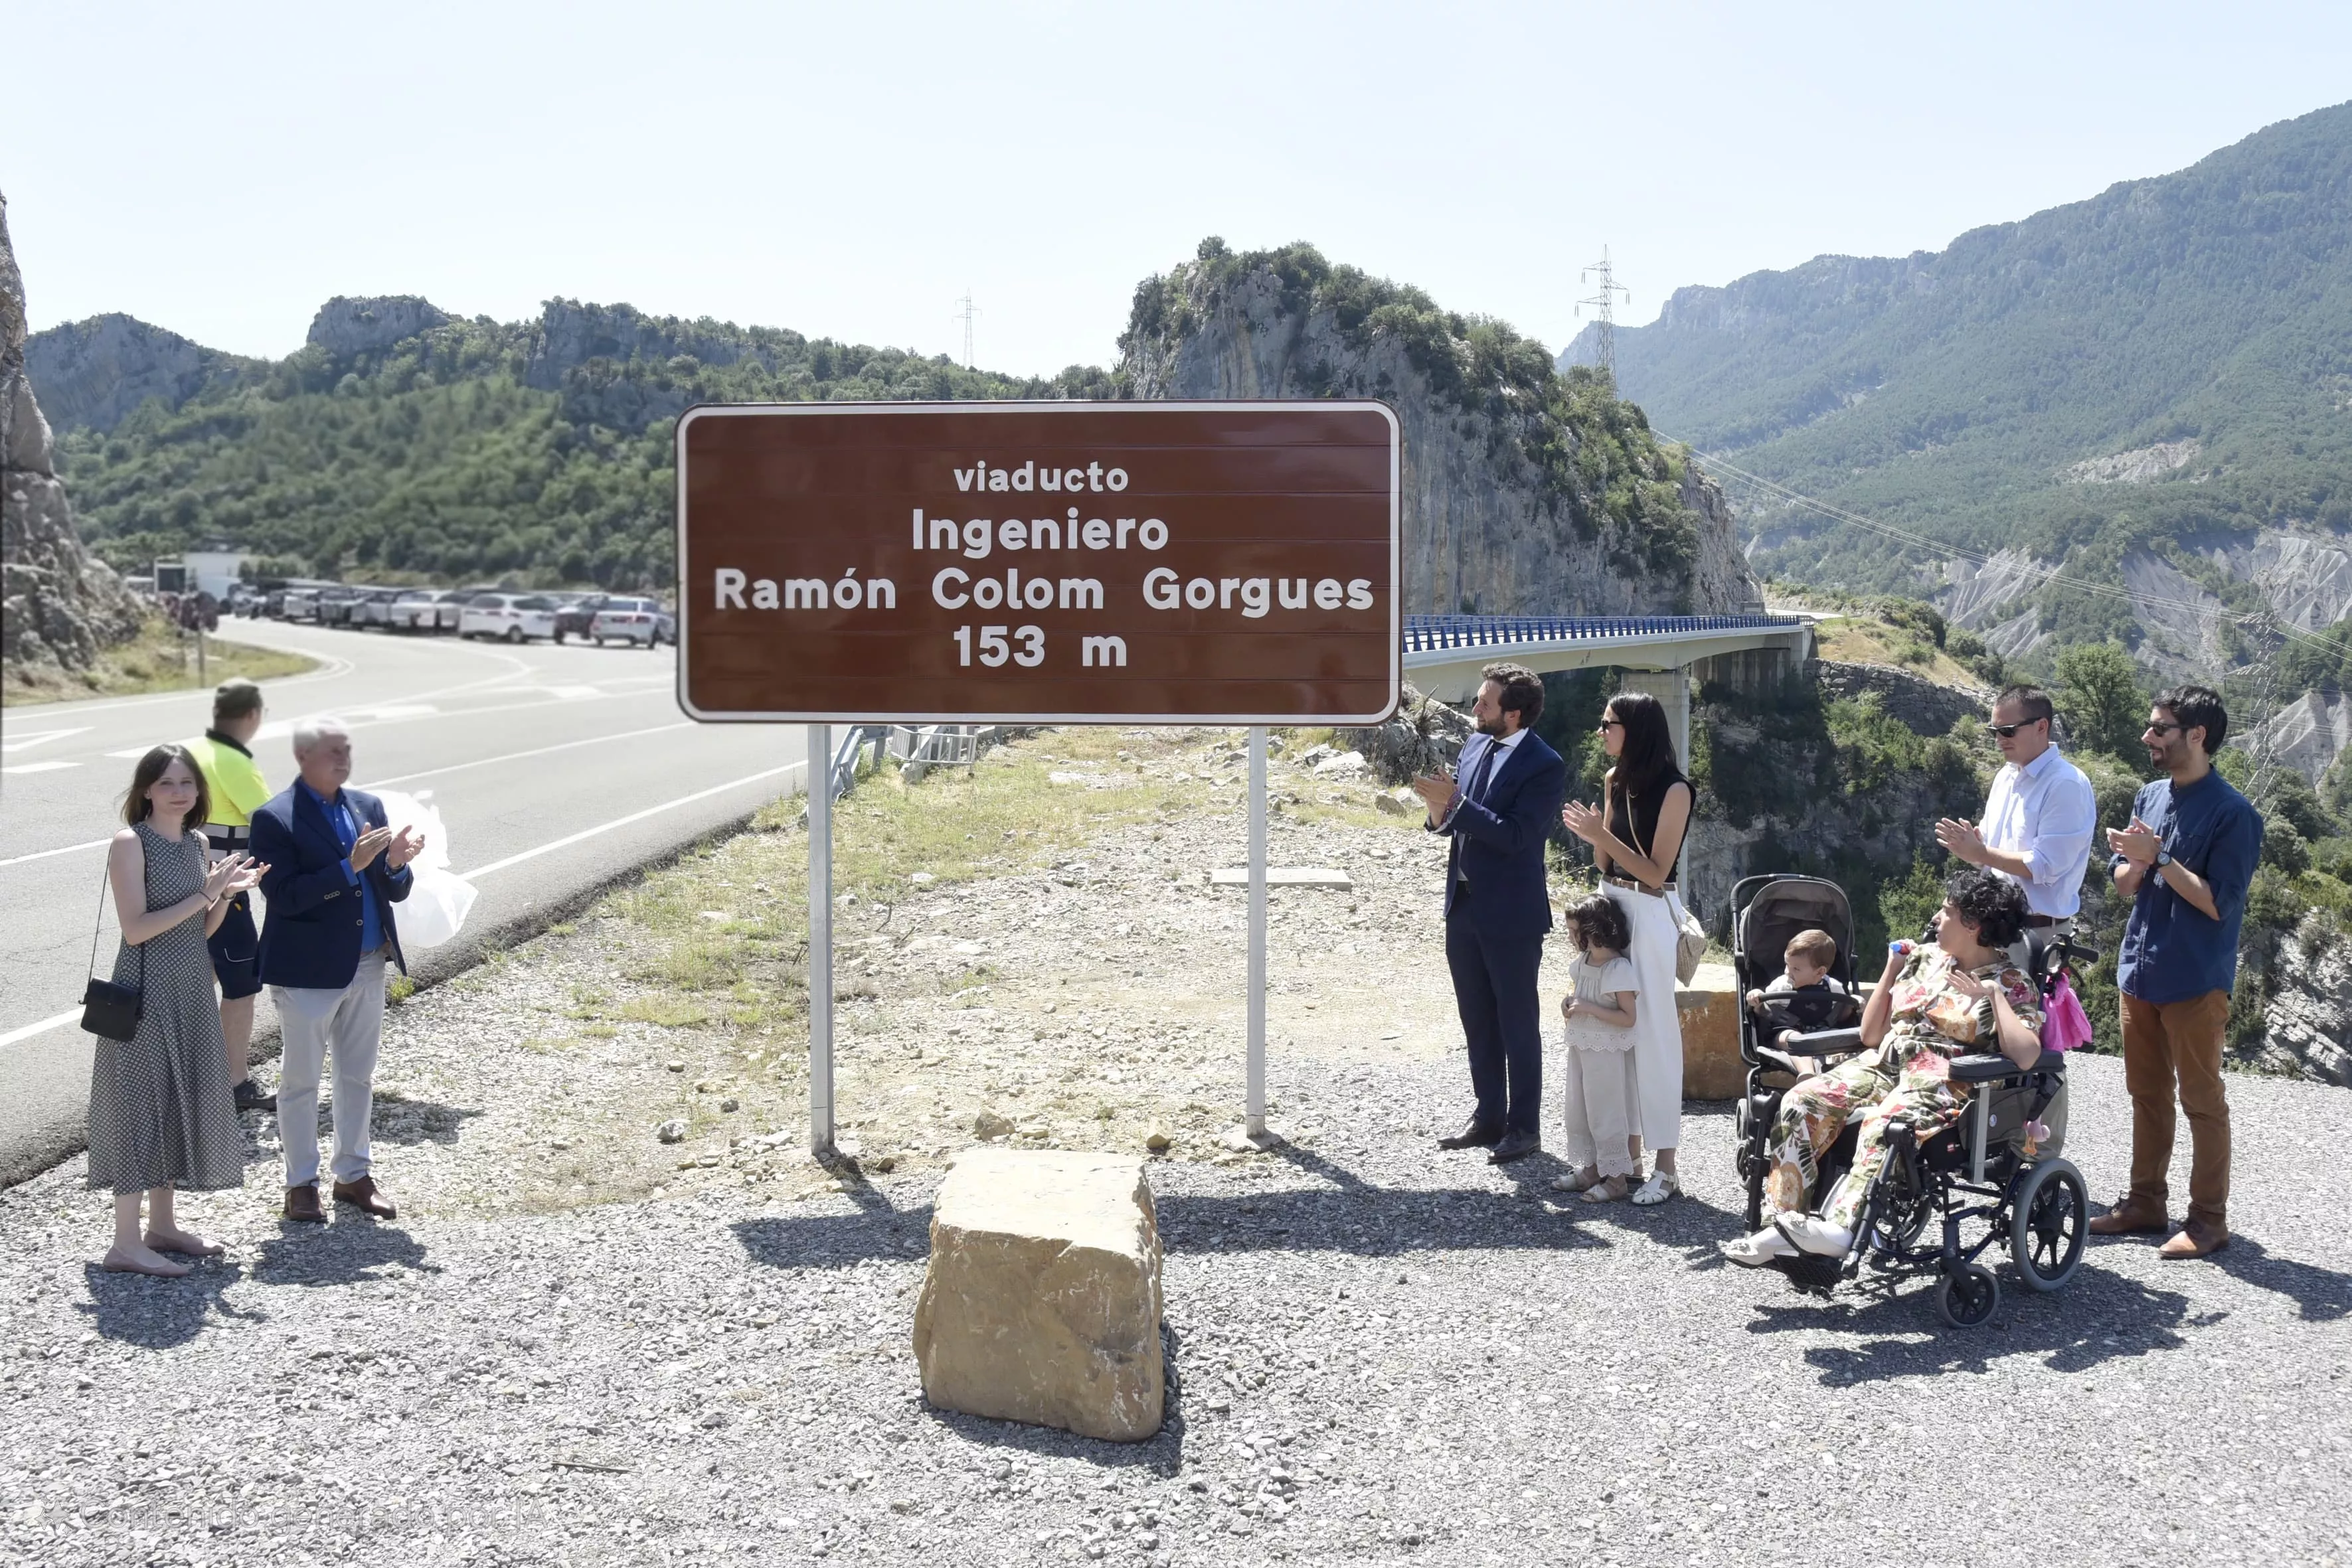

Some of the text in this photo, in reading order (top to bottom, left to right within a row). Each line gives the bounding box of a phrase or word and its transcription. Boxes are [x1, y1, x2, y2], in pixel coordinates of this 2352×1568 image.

[954, 461, 1128, 492] viaducto
[913, 507, 1168, 558] Ingeniero
[715, 568, 1373, 618] Ramón Colom Gorgues
[954, 625, 1126, 666] 153 m
